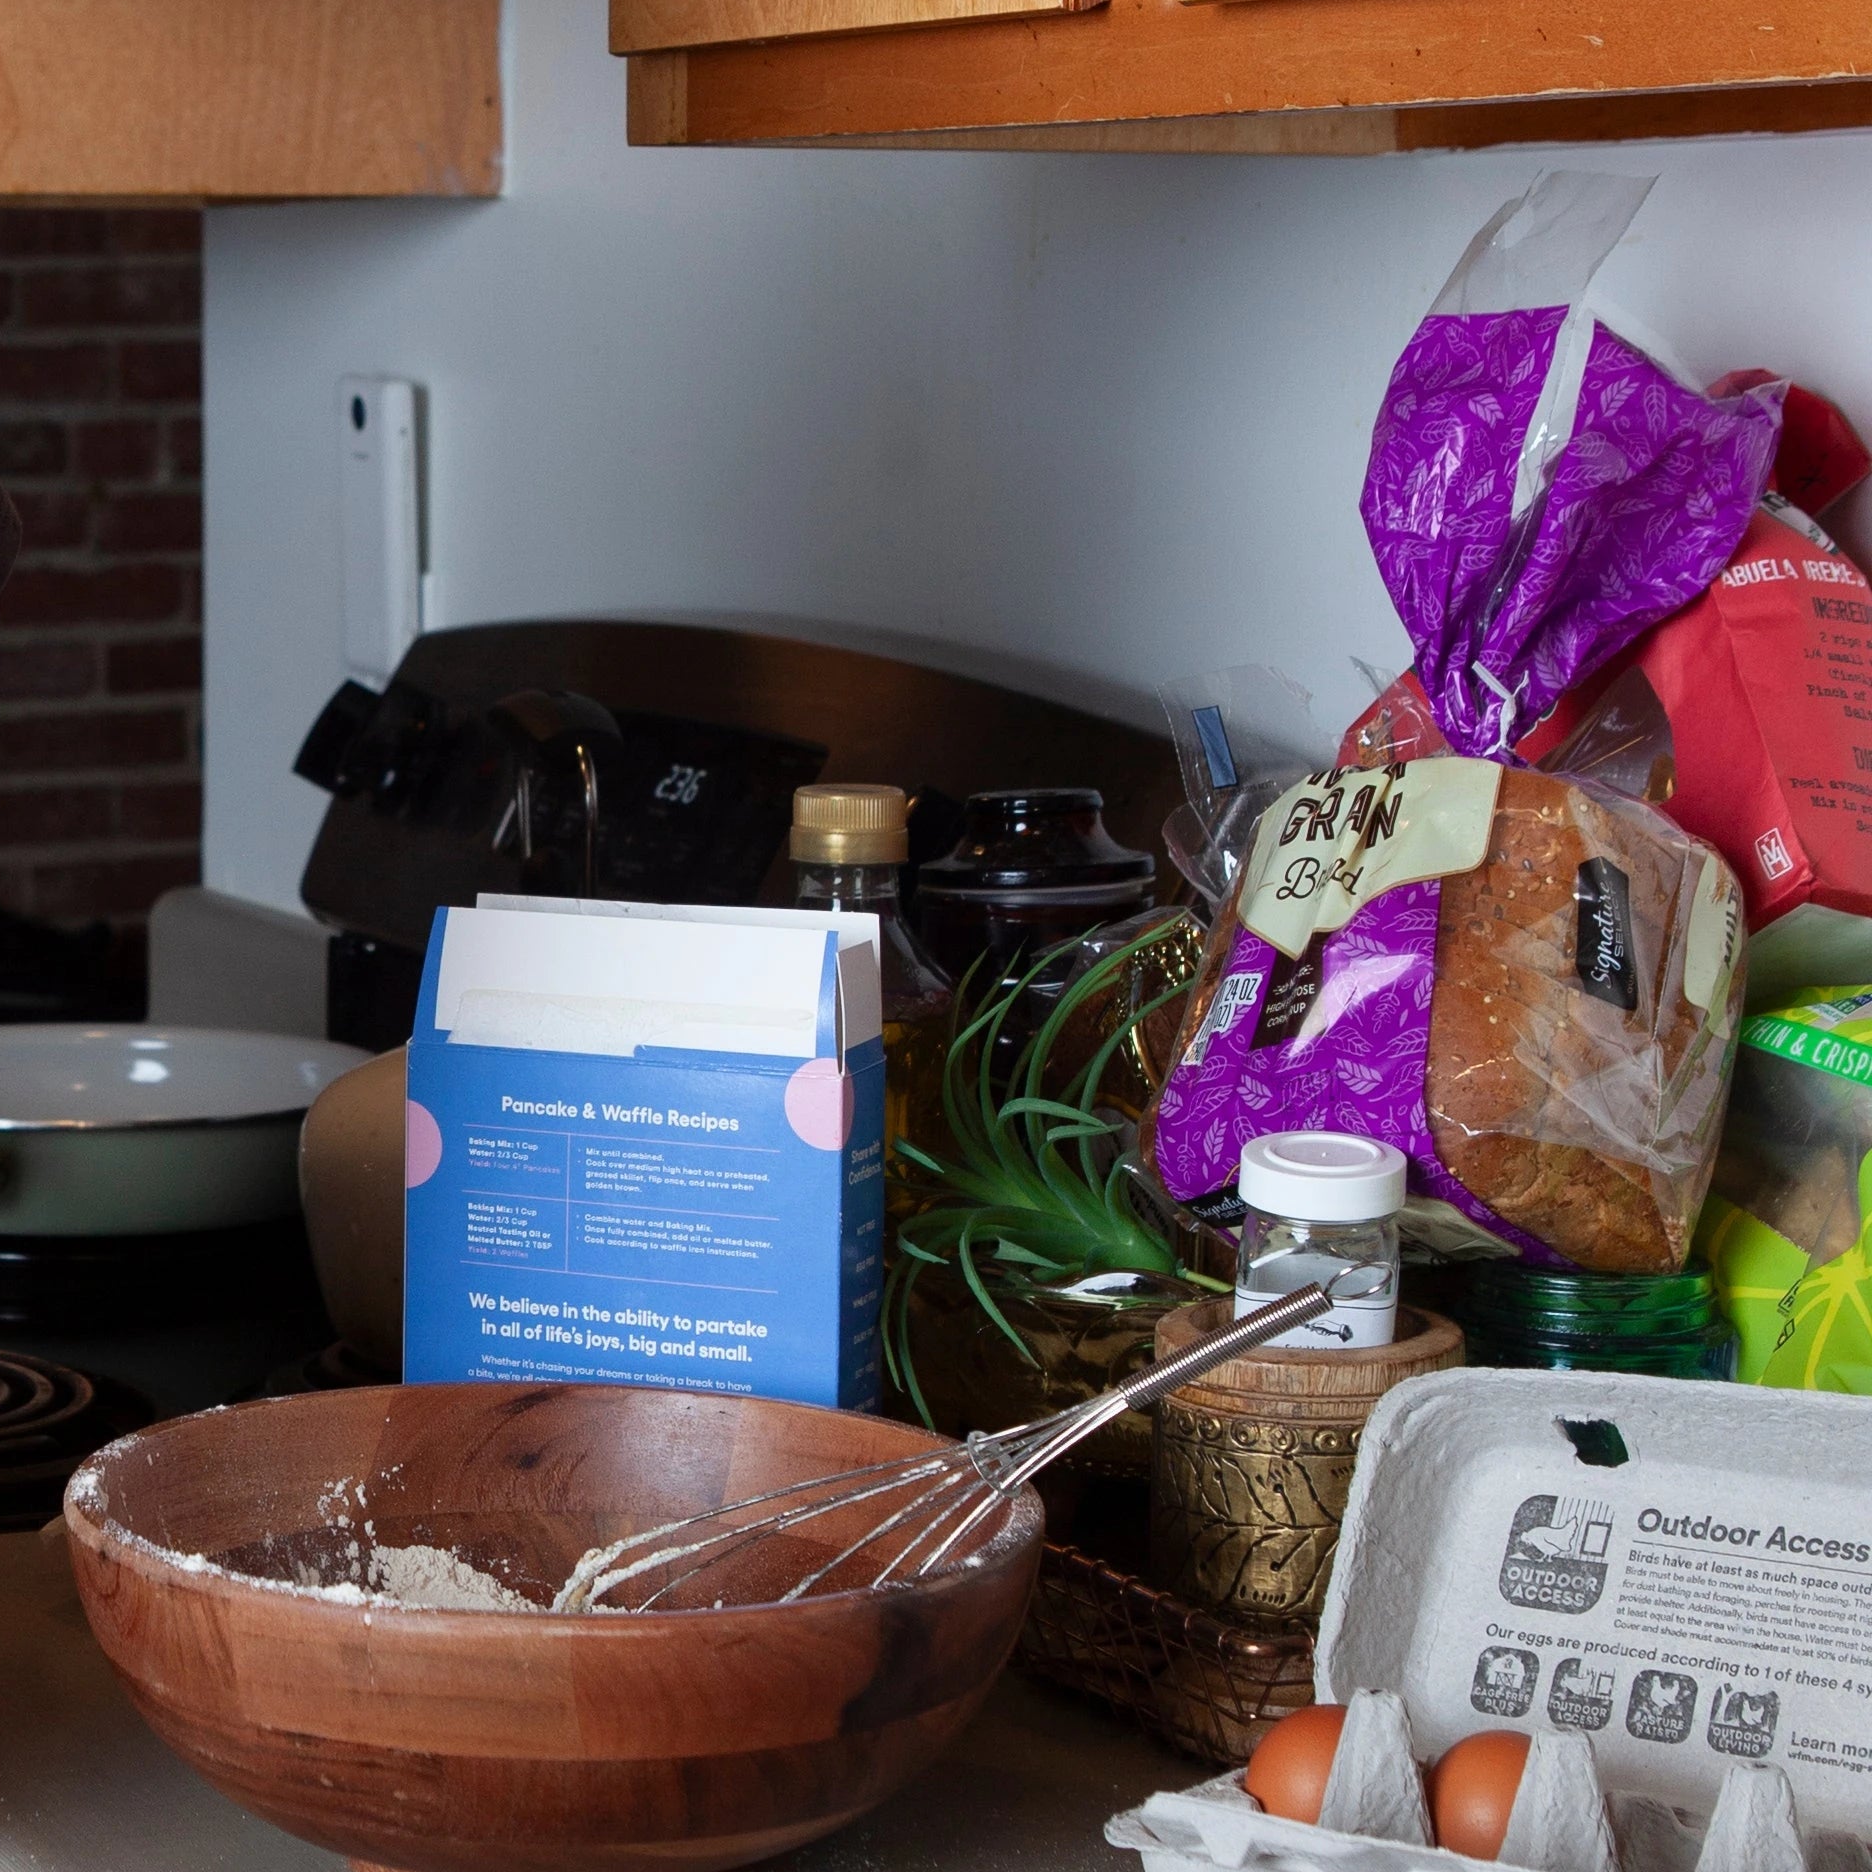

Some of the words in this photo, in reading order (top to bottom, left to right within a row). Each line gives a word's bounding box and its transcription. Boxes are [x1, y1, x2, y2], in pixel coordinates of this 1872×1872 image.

[1721, 558, 1799, 589] ABUELA
[1789, 778, 1824, 789] Peel
[1590, 880, 1622, 990] Signature
[1239, 978, 1258, 1000] OZ
[1742, 1018, 1794, 1049] THIN
[1790, 1032, 1808, 1057] &
[502, 1096, 578, 1117] Pancake
[583, 1103, 596, 1119] &
[602, 1104, 663, 1125] Waffle
[668, 1110, 739, 1132] Recipes
[469, 1137, 495, 1148] Baking
[498, 1140, 514, 1148] Mix:
[522, 1142, 538, 1151] Cup
[469, 1148, 495, 1157] Water:
[497, 1151, 510, 1159] 2/3
[512, 1152, 528, 1161] Cup
[851, 1144, 869, 1164] Share
[622, 1153, 664, 1161] combined.
[586, 1159, 607, 1167] Cook
[628, 1164, 660, 1172] medium
[663, 1165, 681, 1175] high
[683, 1167, 702, 1175] heat
[724, 1172, 770, 1182] preheated,
[586, 1171, 618, 1179] greased
[620, 1173, 646, 1183] skillet,
[649, 1175, 663, 1184] flip
[664, 1178, 686, 1186] once,
[732, 1183, 754, 1191] when
[586, 1182, 613, 1190] golden
[615, 1183, 642, 1192] brown.
[468, 1203, 494, 1213] Baking
[496, 1205, 513, 1213] Mix:
[521, 1208, 537, 1216] Cup
[1192, 1196, 1244, 1219] Signatu
[468, 1213, 494, 1223] Water:
[496, 1216, 509, 1224] 2/3
[512, 1218, 528, 1227] Cup
[468, 1224, 497, 1233] Neutral
[499, 1227, 527, 1238] Tasting
[529, 1230, 540, 1238] Oil
[585, 1214, 621, 1224] Combine
[666, 1221, 694, 1232] Baking
[696, 1224, 713, 1232] Mix.
[584, 1235, 605, 1244] Cook
[607, 1239, 648, 1250] according
[660, 1244, 686, 1252] waffle
[689, 1245, 705, 1254] iron
[707, 1247, 759, 1258] instructions.
[585, 1225, 605, 1233] Once
[608, 1227, 625, 1237] fully
[627, 1230, 670, 1240] combined,
[714, 1238, 742, 1246] melted
[745, 1239, 773, 1249] butter.
[469, 1292, 496, 1310] We
[500, 1296, 559, 1317] believe
[563, 1302, 578, 1319] in
[582, 1305, 611, 1322] the
[615, 1309, 670, 1331] ability
[673, 1315, 691, 1330] to
[696, 1320, 767, 1337] partake
[482, 1318, 496, 1335] in
[500, 1322, 520, 1338] all
[524, 1324, 542, 1340] of
[546, 1326, 583, 1345] life's
[586, 1330, 624, 1352] joys,
[629, 1335, 656, 1356] big
[661, 1341, 695, 1356] and
[699, 1345, 752, 1362] small.
[482, 1355, 521, 1367] Whether
[522, 1359, 534, 1369] it's
[536, 1361, 572, 1375] chasing
[574, 1367, 595, 1375] your
[596, 1368, 632, 1380] dreams
[646, 1374, 675, 1386] taking
[686, 1377, 713, 1388] break
[716, 1381, 726, 1389] to
[728, 1381, 752, 1392] have
[1638, 1508, 1761, 1546] Outdoor
[1765, 1526, 1870, 1562] Access
[1507, 1566, 1598, 1592] OUTDOOR
[1629, 1550, 1659, 1565] Birds
[1663, 1554, 1692, 1569] have
[1695, 1561, 1708, 1572] at
[1711, 1561, 1742, 1576] least
[1745, 1569, 1759, 1579] as
[1762, 1572, 1797, 1584] much
[1801, 1577, 1838, 1590] space
[1511, 1583, 1585, 1608] ACCESS
[1486, 1623, 1515, 1639] Our
[1518, 1632, 1553, 1647] eggs
[1557, 1638, 1581, 1649] are
[1584, 1642, 1657, 1661] produced
[1661, 1653, 1740, 1677] according
[1745, 1664, 1759, 1677] to
[1765, 1667, 1771, 1679] 1
[1774, 1668, 1792, 1682] of
[1796, 1671, 1838, 1690] these
[1843, 1680, 1852, 1692] 4
[1474, 1686, 1530, 1704] CAGE-FREE
[1485, 1699, 1515, 1713] PLUS
[1552, 1700, 1608, 1718] OUTDOOR
[1557, 1712, 1600, 1727] ACCESS
[1713, 1727, 1772, 1747] OUTDOOR
[1718, 1739, 1760, 1753] LIVING
[1791, 1731, 1836, 1753] Learn
